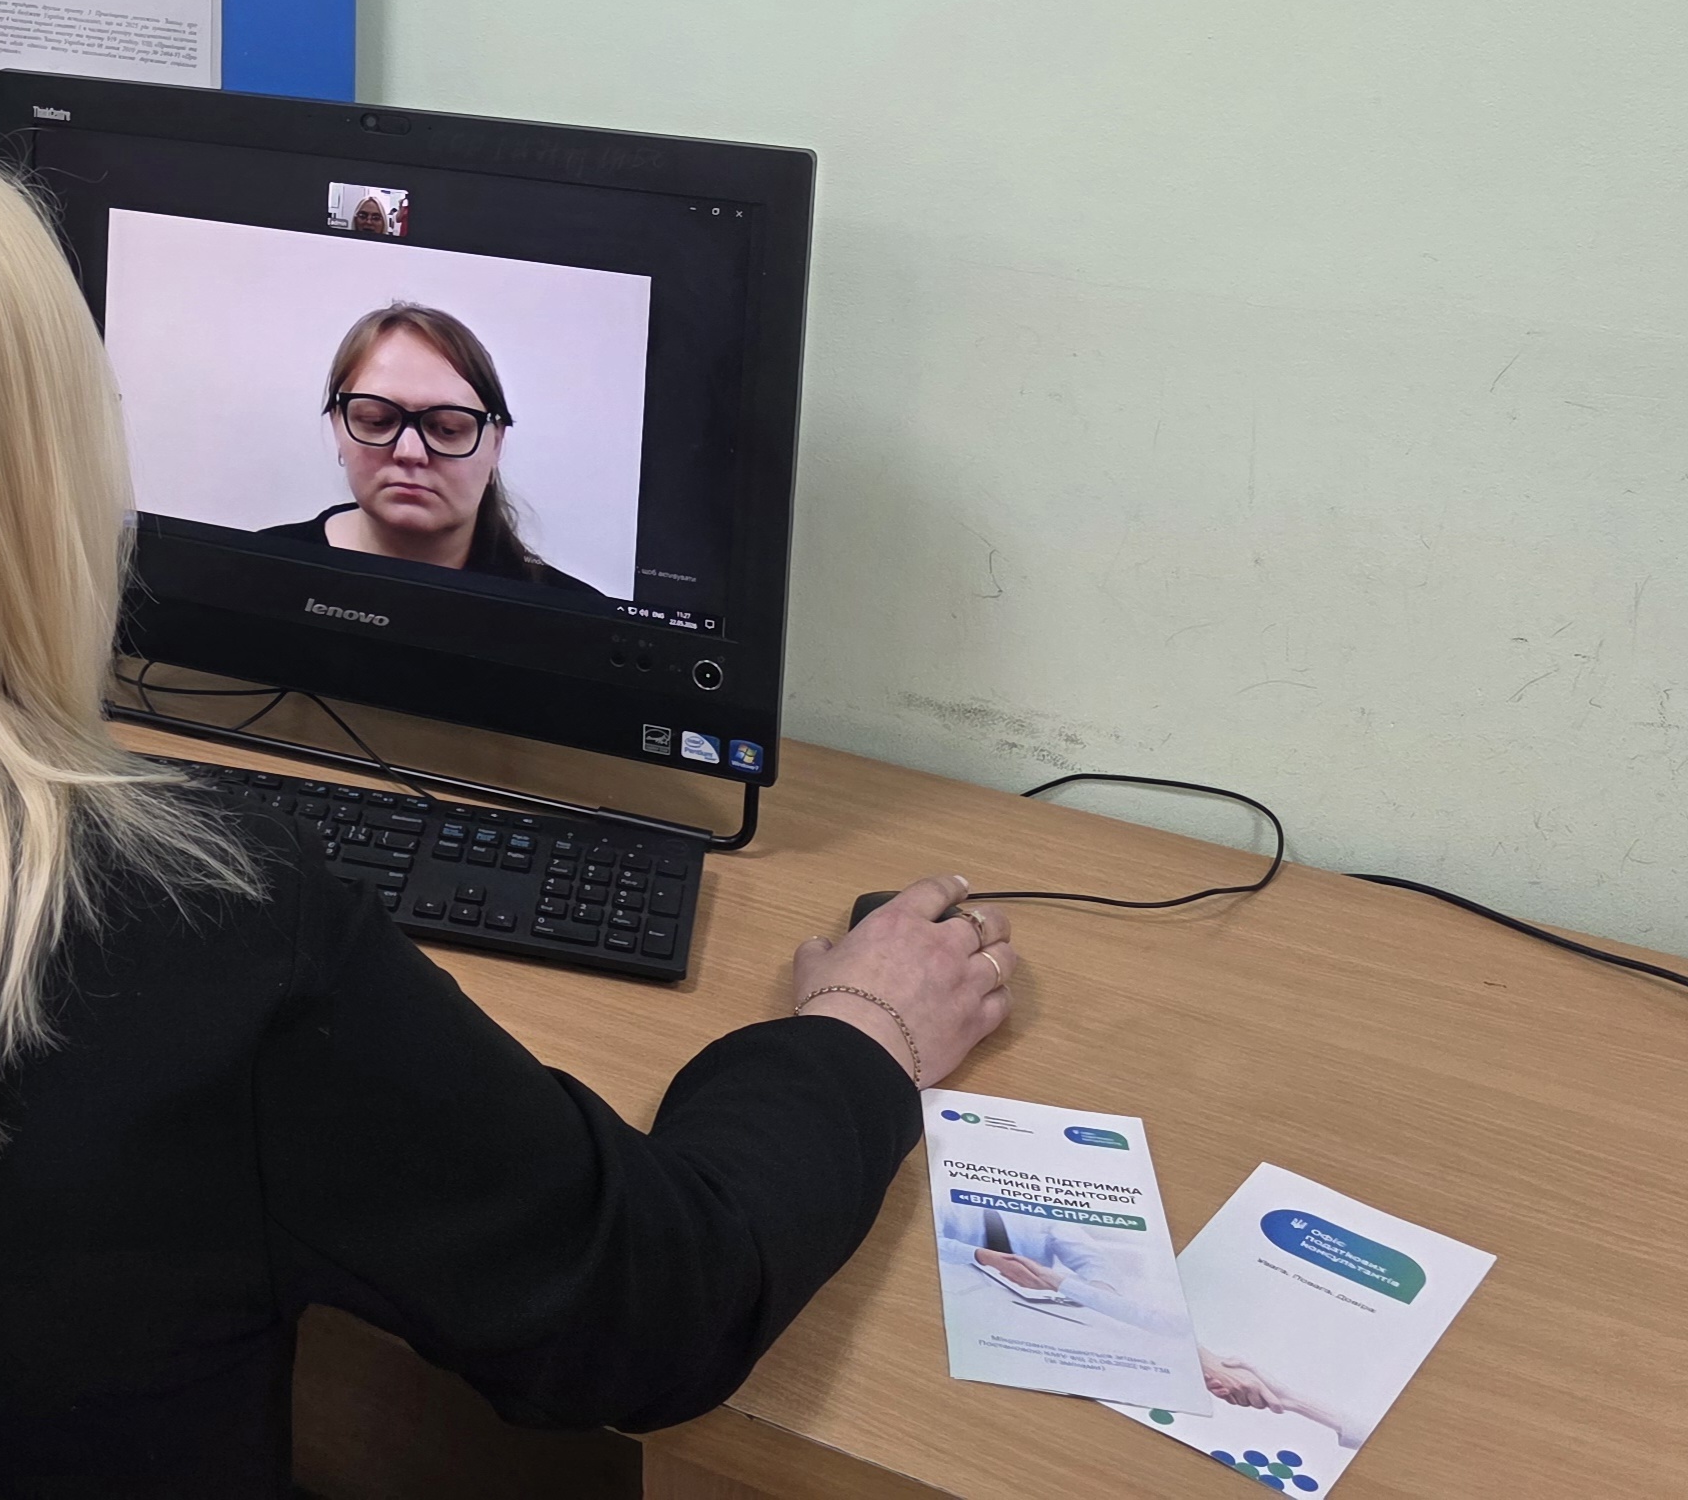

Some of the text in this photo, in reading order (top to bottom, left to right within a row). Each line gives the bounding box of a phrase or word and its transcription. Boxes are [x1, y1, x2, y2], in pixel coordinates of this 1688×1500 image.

[304, 597, 391, 629] lenovo
[676, 611, 691, 619] 11:27
[943, 1160, 1143, 1195] ПОДАТКОВА ПІДТРИМКА
[948, 1170, 1136, 1204] УЧАСНИКІВ ГРАНТОВОЇ
[959, 1194, 1138, 1226] «ВЛАСНА СПРАВА»
[1001, 1189, 1090, 1209] ПРОГРАМИ
[1305, 1235, 1387, 1273] податкових
[1311, 1228, 1346, 1248] Офіс
[1300, 1241, 1400, 1288] консультантів
